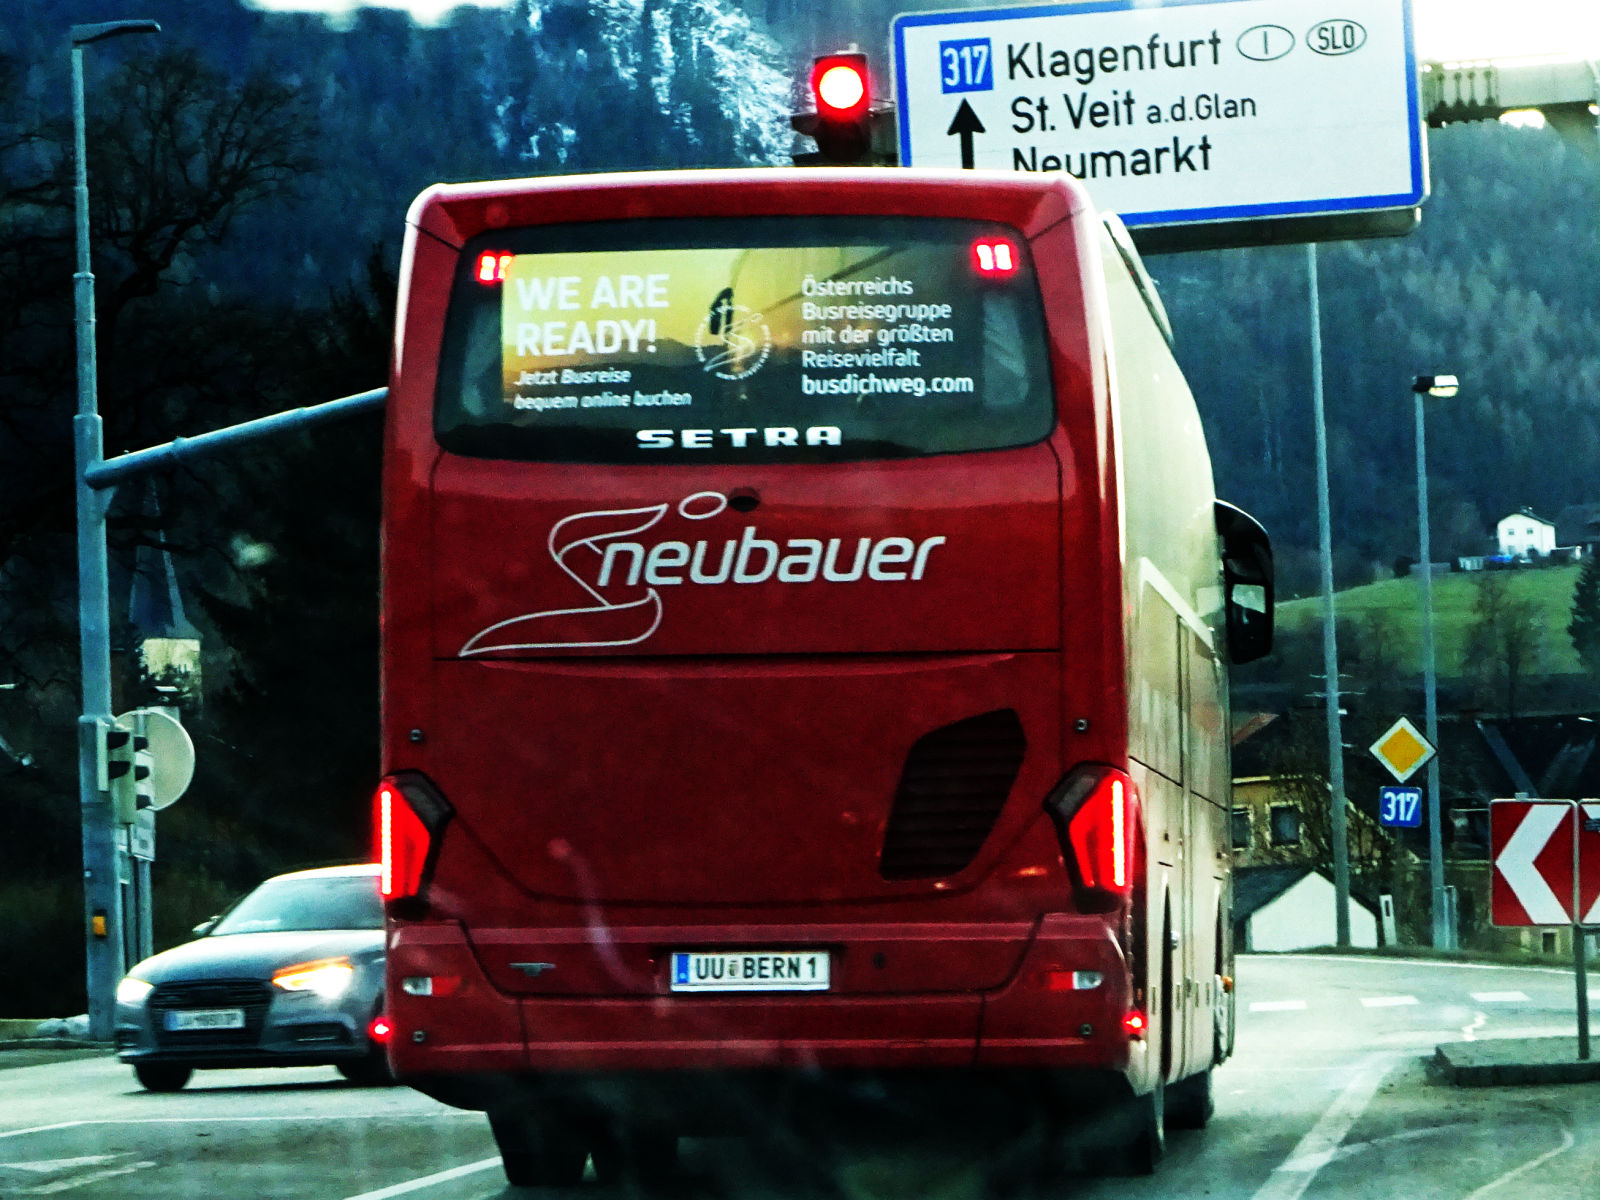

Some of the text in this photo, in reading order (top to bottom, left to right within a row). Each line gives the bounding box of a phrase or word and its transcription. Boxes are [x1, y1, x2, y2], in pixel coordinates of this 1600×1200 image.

[1317, 26, 1356, 51] SLO
[943, 44, 989, 87] 317
[1007, 29, 1221, 85] Klagenfurt
[1011, 94, 1056, 134] St.
[1063, 90, 1135, 130] Veit
[1012, 134, 1212, 179] Neumarkt
[516, 273, 670, 311] WE ARE
[802, 274, 914, 297] Österreichs
[802, 301, 952, 322] Busreisegruppe
[516, 318, 657, 357] READY!
[802, 324, 954, 346] mit der größten
[802, 348, 921, 368] Reisevielfalt
[514, 367, 632, 386] Jetzt Busreise
[801, 372, 975, 397] busdichweg.com
[513, 389, 693, 412] bequem online buchen
[636, 426, 842, 449] SETRA
[597, 526, 946, 586] neubauer
[1382, 791, 1419, 822] 317
[695, 956, 817, 979] UU BERN 1
